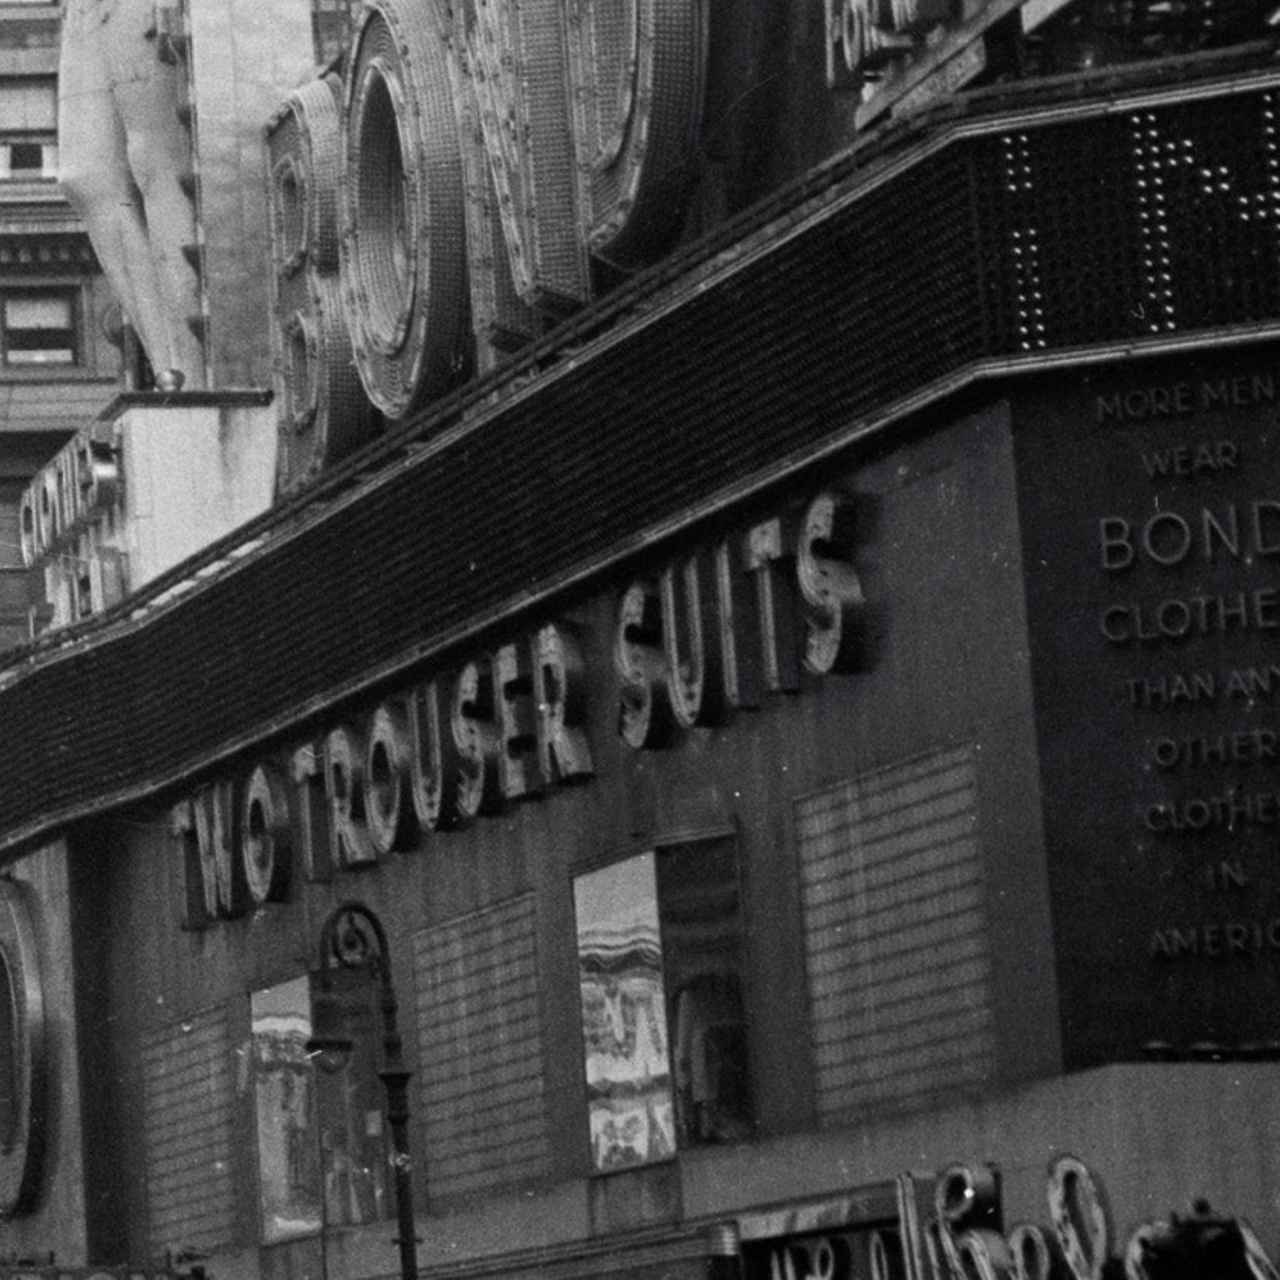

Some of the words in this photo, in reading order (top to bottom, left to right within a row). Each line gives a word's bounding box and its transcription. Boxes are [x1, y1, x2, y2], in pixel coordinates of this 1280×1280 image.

[1096, 383, 1192, 422] MORE
[1201, 376, 1275, 408] MEN
[1141, 441, 1237, 477] WEAR
[1100, 501, 1280, 568] BOND
[1101, 588, 1280, 640] CLOTHE
[1126, 674, 1215, 704] THAN
[171, 767, 280, 928] TWO
[294, 624, 594, 881] TROUSER
[615, 493, 864, 748] SUITS
[1154, 729, 1278, 766] OTHER
[1145, 793, 1280, 830] CLOTHE
[1151, 919, 1280, 955] AMERIC
